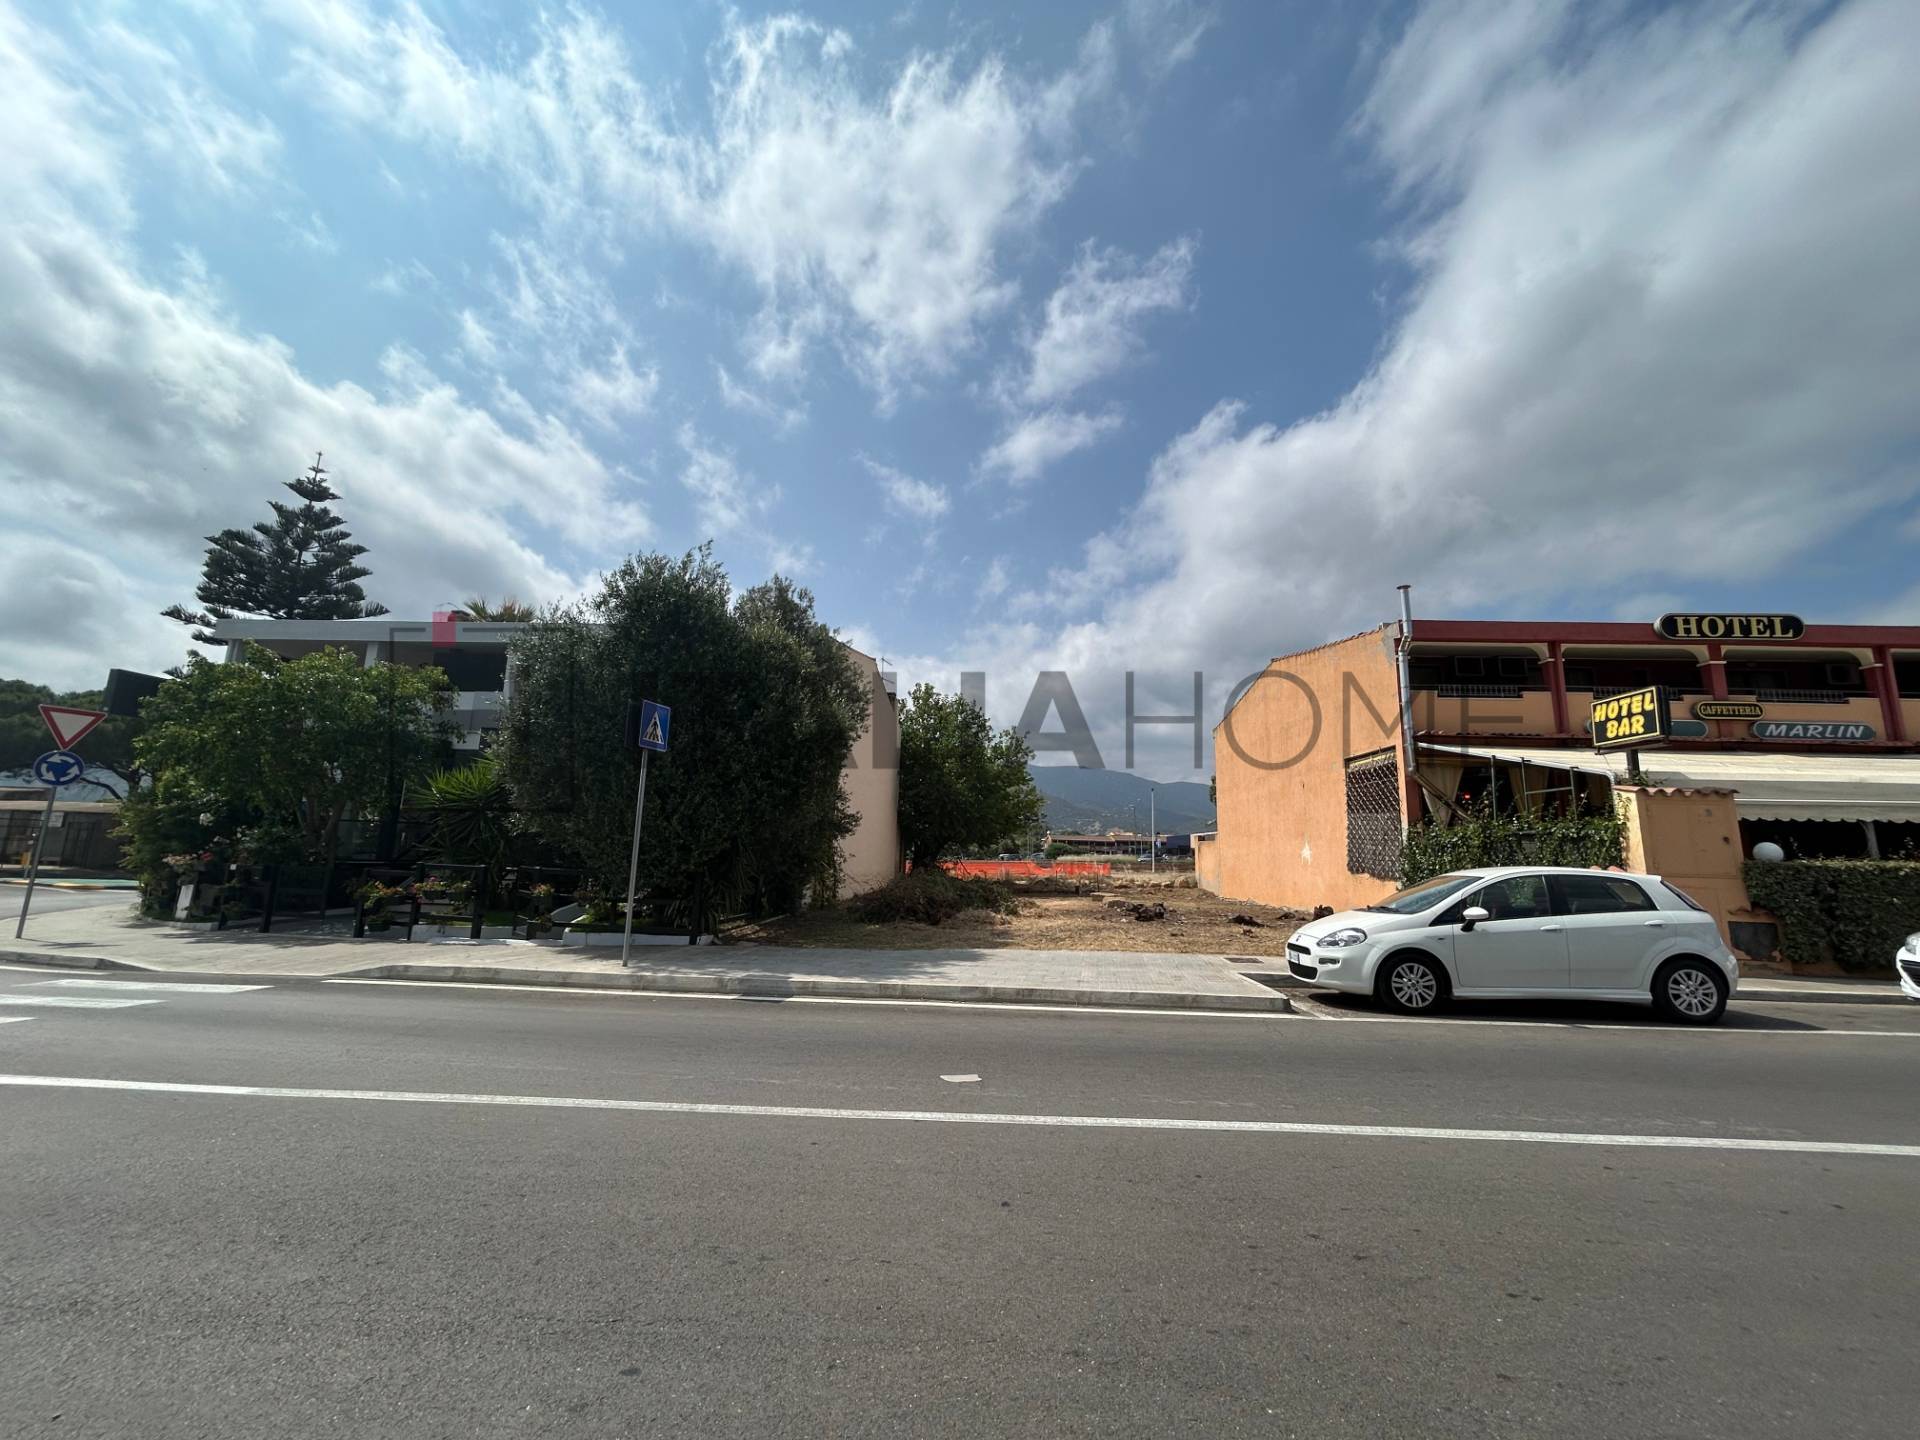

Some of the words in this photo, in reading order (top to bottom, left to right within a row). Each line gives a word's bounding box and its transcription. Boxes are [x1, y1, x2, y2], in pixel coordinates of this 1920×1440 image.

[1674, 616, 1794, 638] HOTEL
[1594, 692, 1655, 722] HOTEL
[1700, 705, 1761, 715] CAFFETTERIA
[1606, 714, 1645, 738] BAR
[1765, 724, 1865, 738] MARLIN
